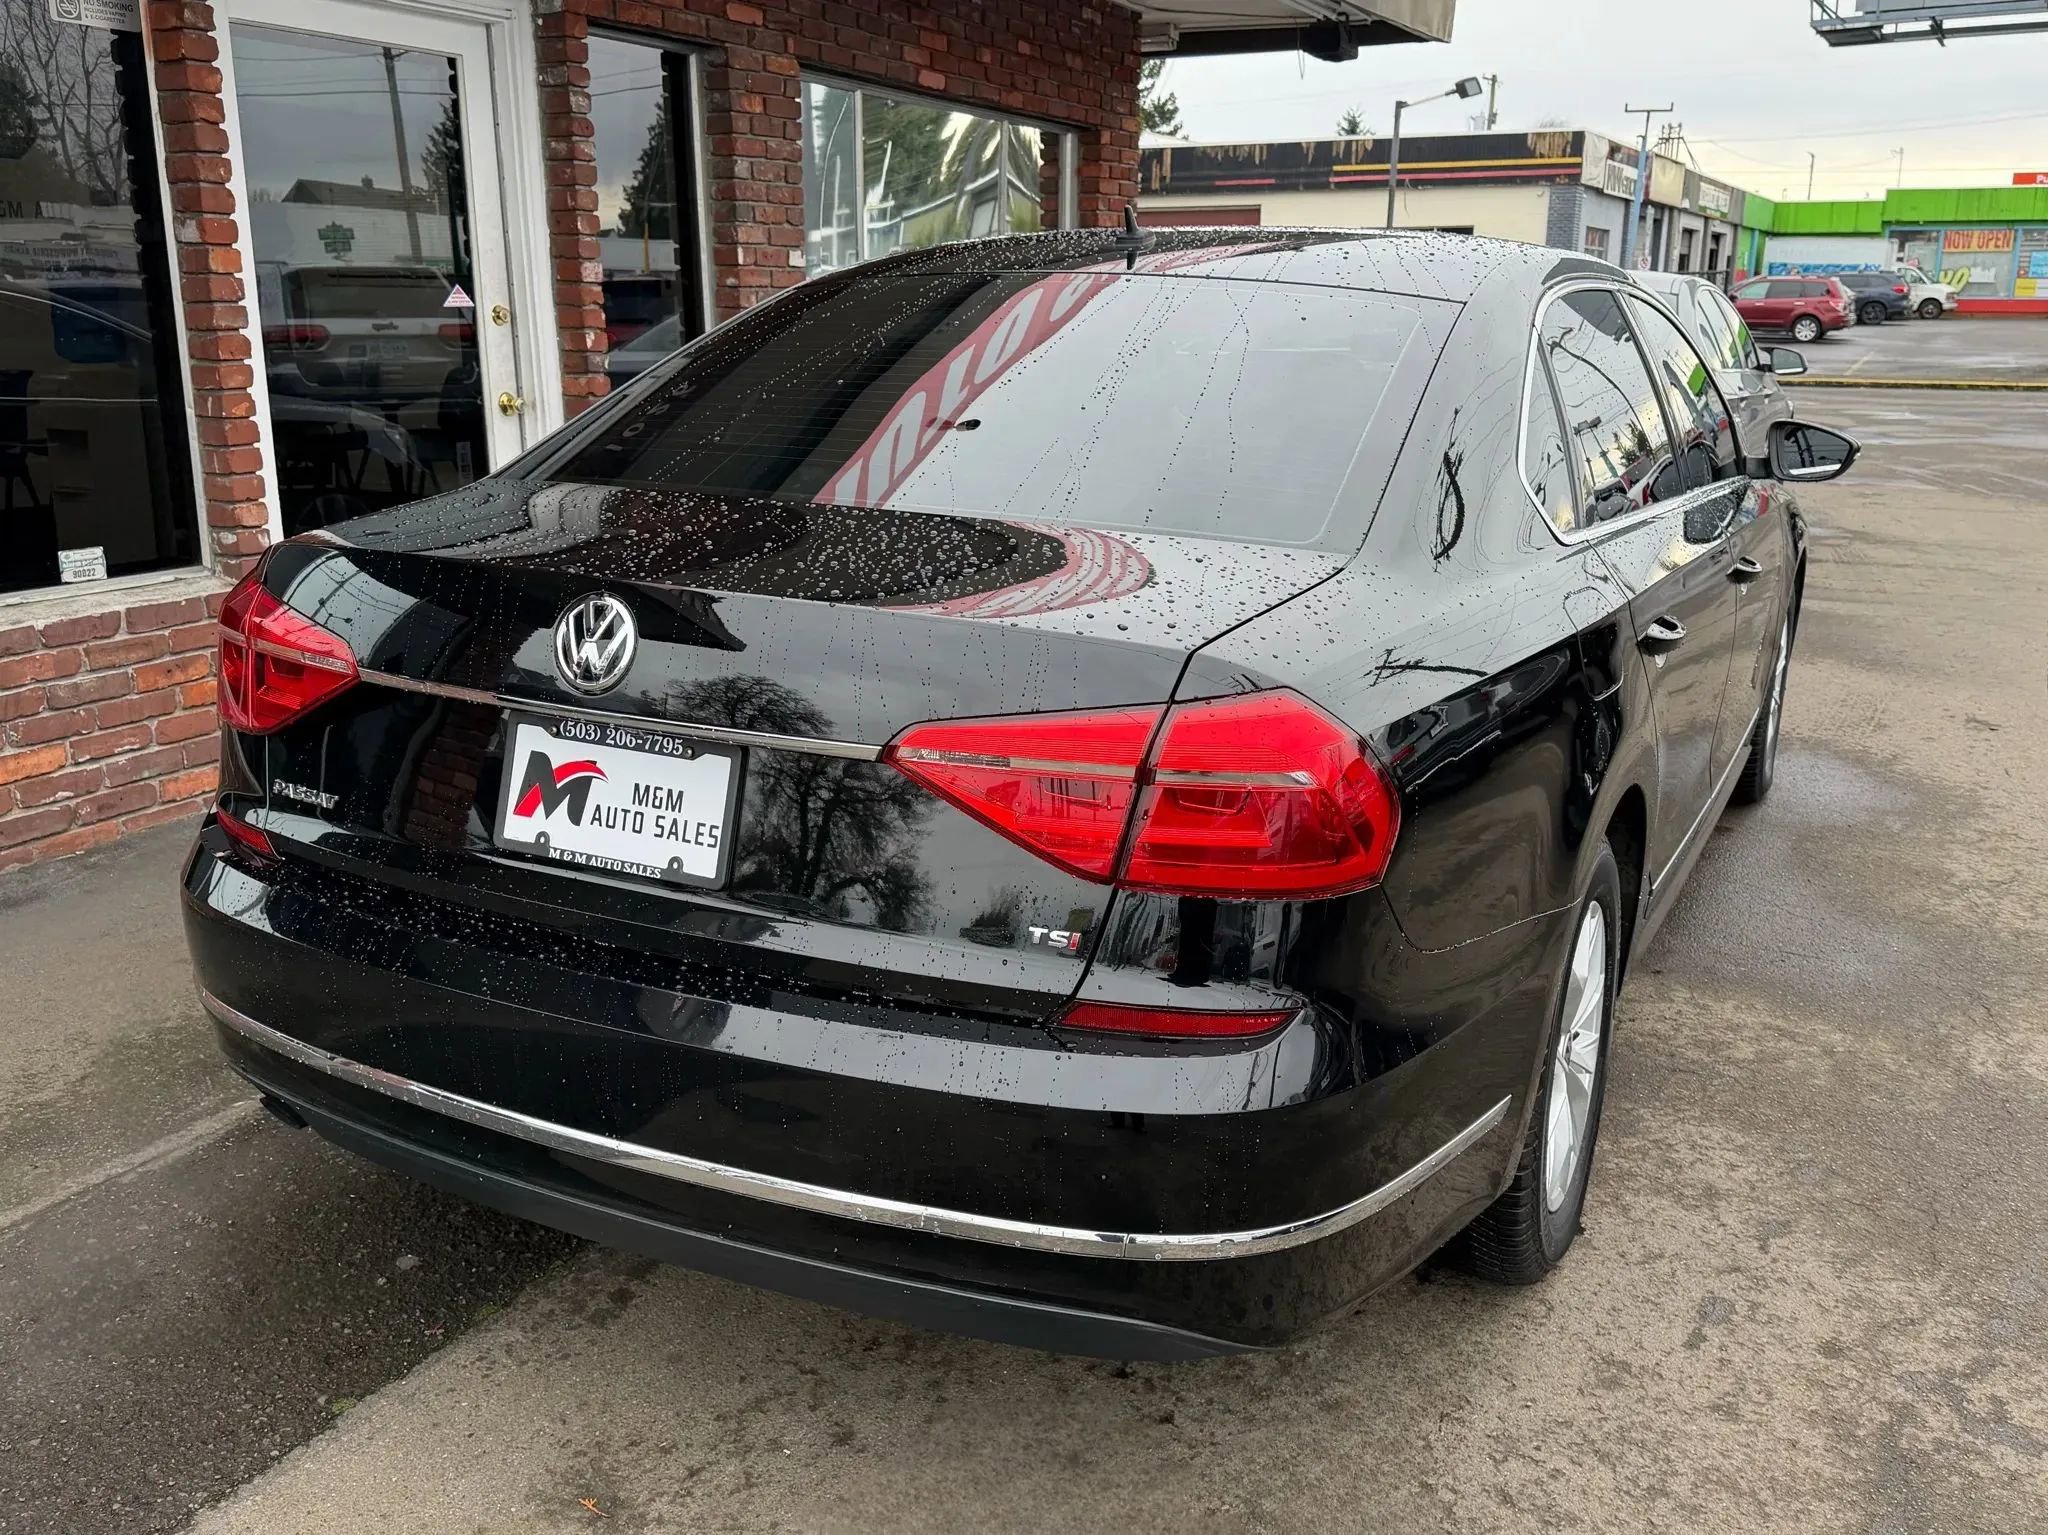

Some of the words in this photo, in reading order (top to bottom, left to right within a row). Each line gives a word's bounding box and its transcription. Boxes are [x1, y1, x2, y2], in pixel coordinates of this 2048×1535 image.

[97, 0, 134, 12] SMOKING
[1943, 231, 1973, 250] NOW
[1977, 230, 2012, 249] OPEN
[559, 720, 601, 742] (503)
[606, 727, 684, 755] 206-7795
[272, 778, 339, 809] PASSAT
[590, 803, 644, 834] AUTO
[653, 815, 720, 848] SALES
[549, 848, 562, 859] M
[563, 851, 573, 862] &
[574, 853, 587, 864] M
[588, 855, 622, 871] AUTO
[623, 861, 662, 879] SALES
[1028, 926, 1081, 950] TSI
